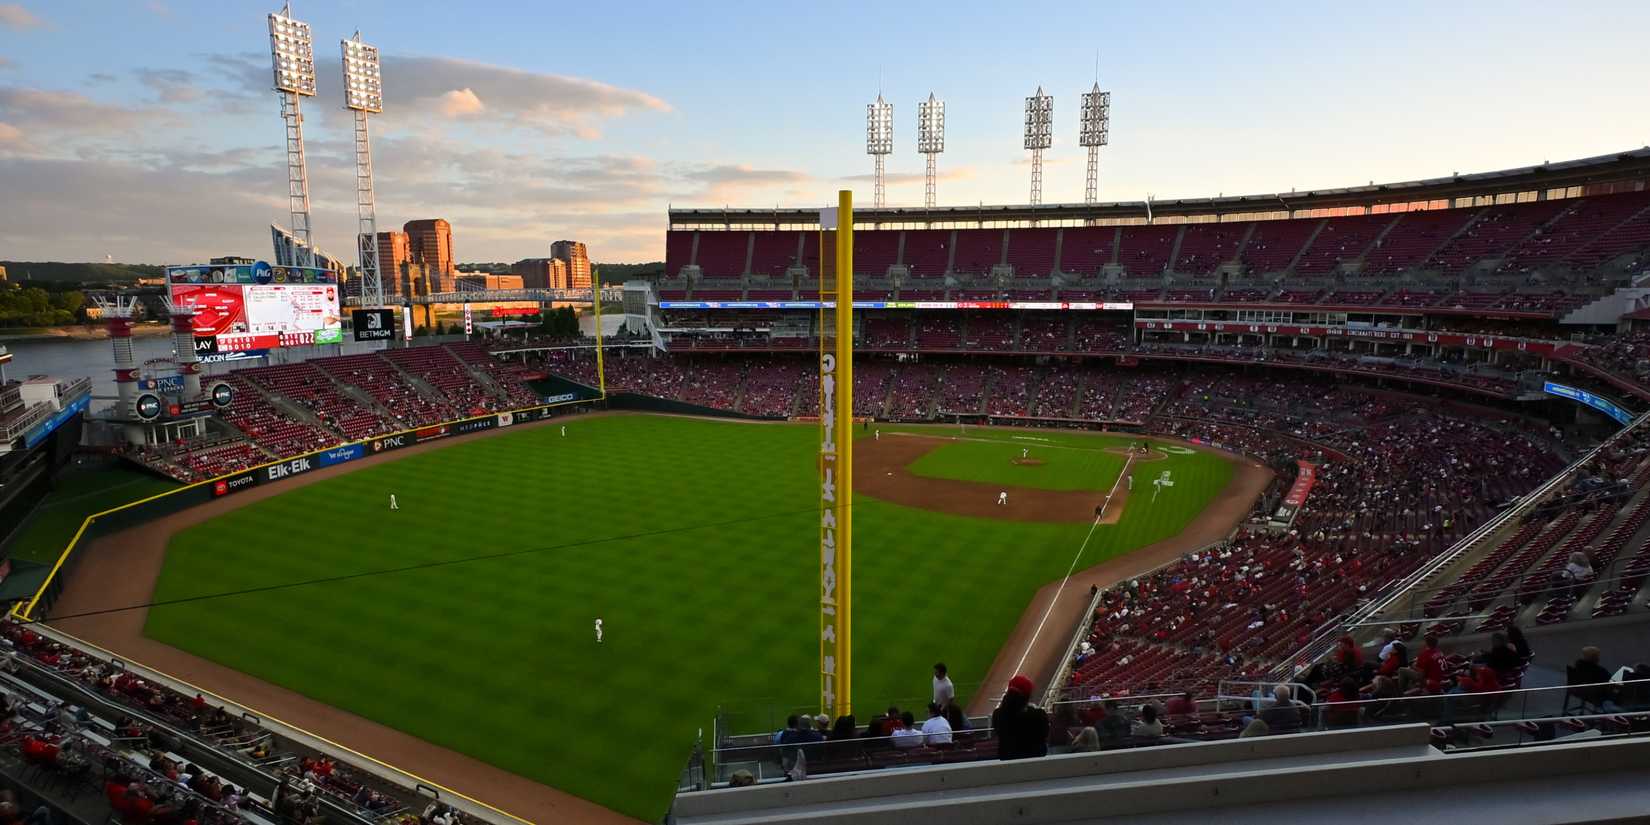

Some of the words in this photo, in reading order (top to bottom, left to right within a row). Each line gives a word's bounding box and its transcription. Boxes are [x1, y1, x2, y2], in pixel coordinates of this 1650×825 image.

[256, 269, 271, 277] P&G
[359, 329, 391, 338] BETMGM
[196, 354, 225, 364] EACON
[157, 378, 177, 388] PNC
[549, 393, 573, 402] GEICO
[384, 436, 404, 448] PNC
[229, 476, 253, 488] TOYOTA
